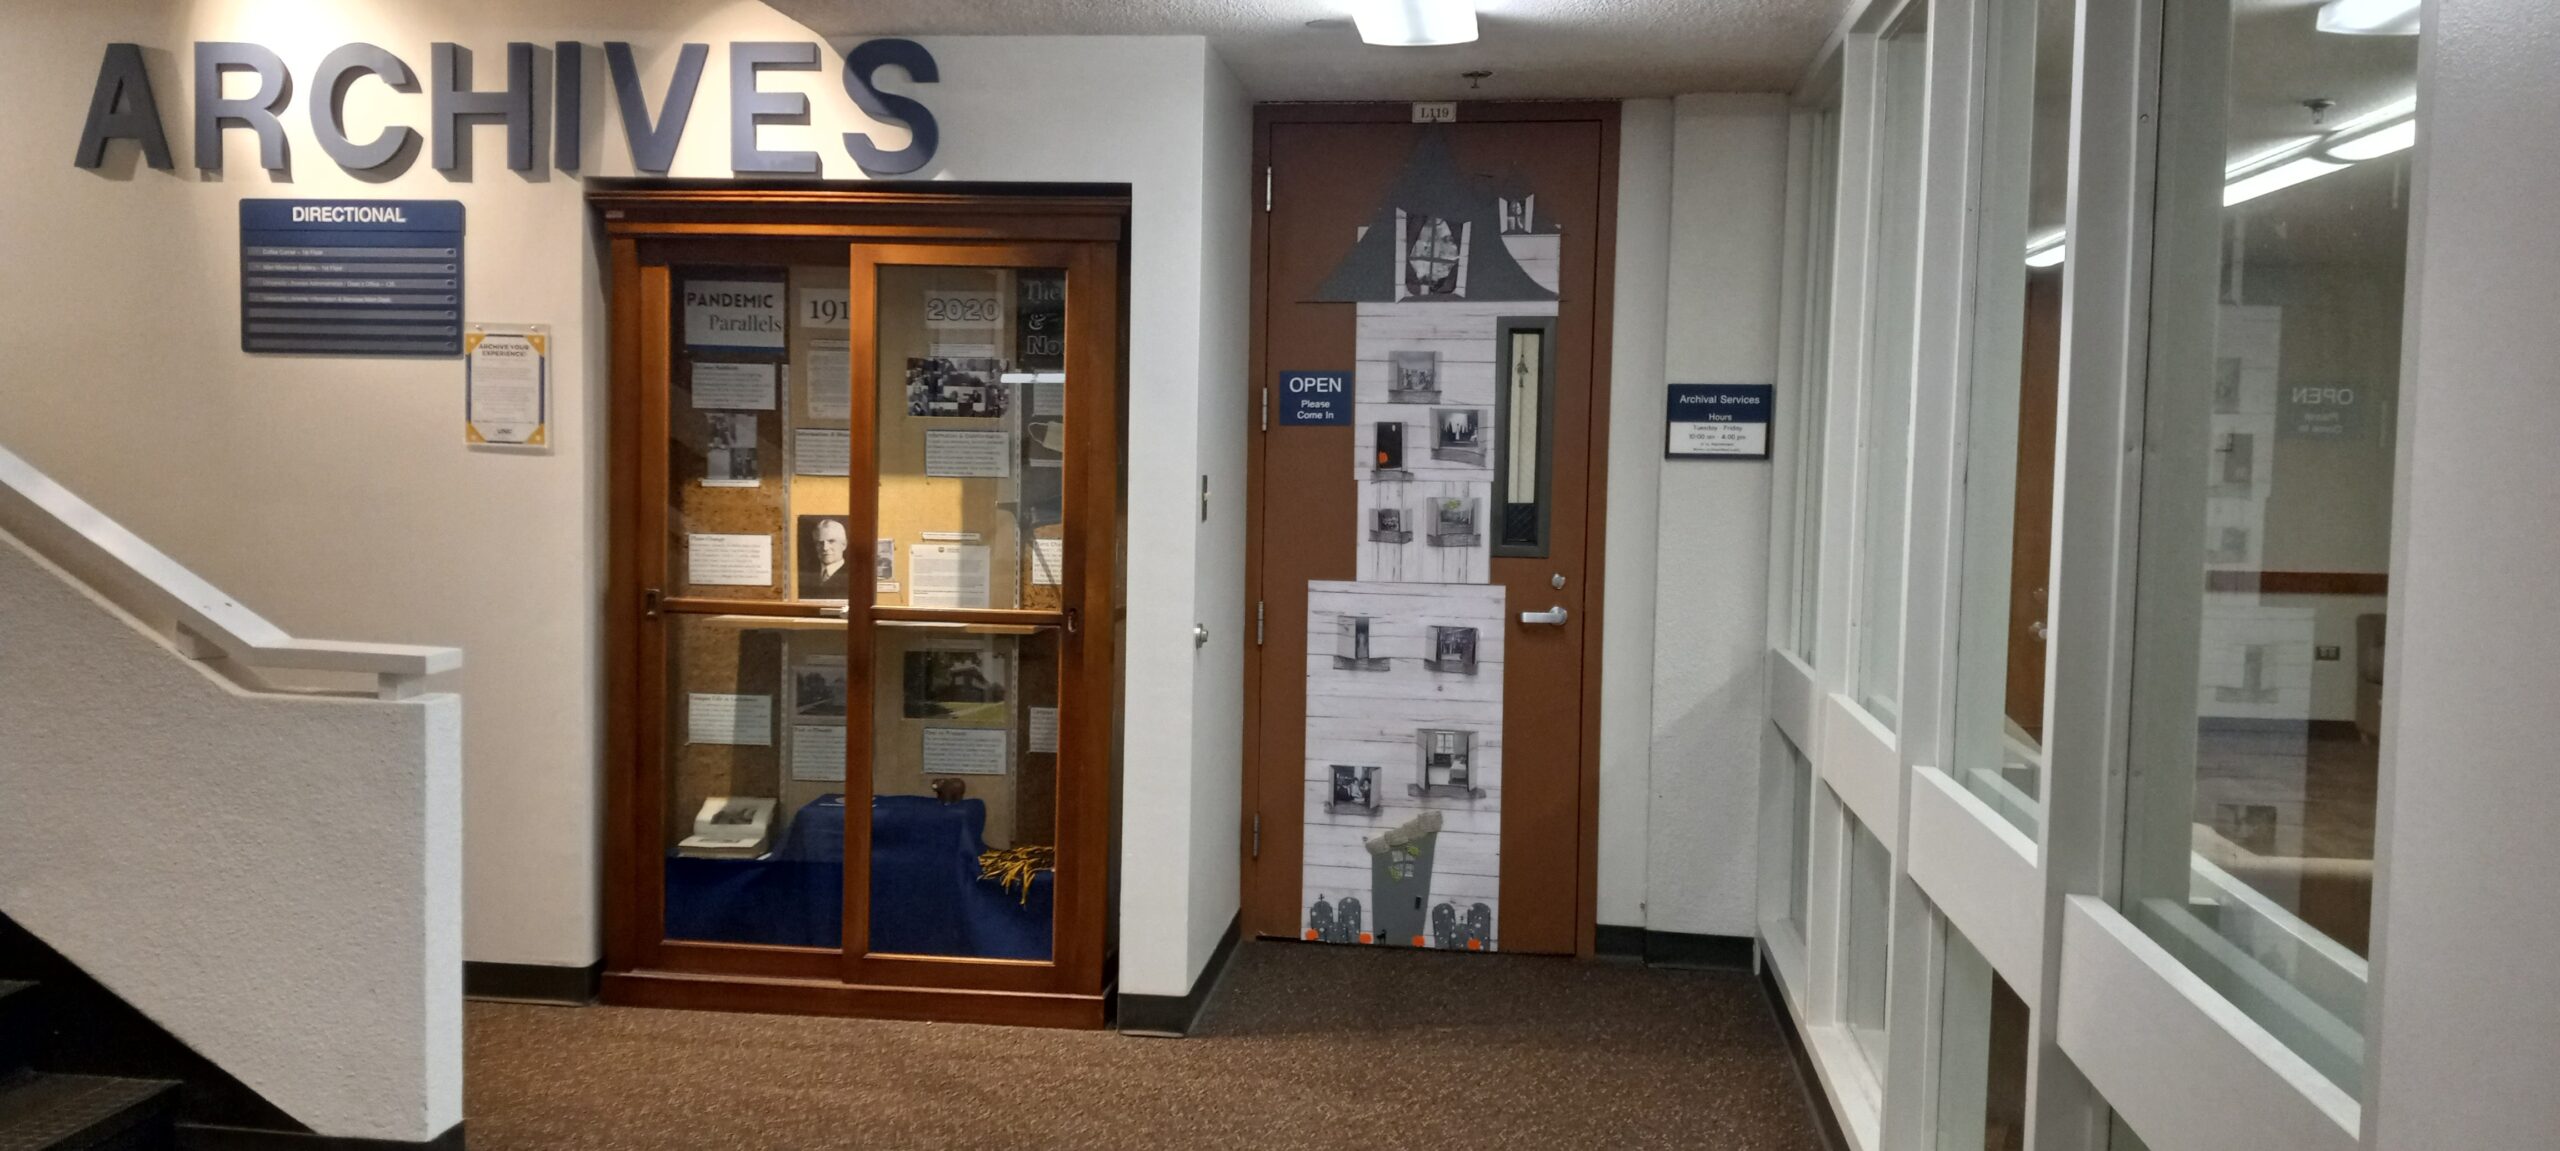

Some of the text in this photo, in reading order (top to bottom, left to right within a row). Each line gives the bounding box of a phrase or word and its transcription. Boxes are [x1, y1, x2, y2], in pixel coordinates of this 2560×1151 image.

[75, 38, 940, 178] ARCHIVES
[1421, 107, 1450, 119] L119
[292, 206, 406, 223] DIRECTIONAL
[1024, 280, 1064, 303] The
[687, 292, 774, 309] PANDEMIC
[926, 297, 1000, 321] 2020
[809, 298, 850, 324] 191
[709, 314, 783, 333] Parallels
[1028, 312, 1047, 330] &
[1026, 335, 1063, 356] No
[1289, 377, 1342, 393] OPEN
[1300, 399, 1331, 409] Please
[1679, 394, 1760, 404] Archival Services
[1296, 410, 1335, 420] Come In
[1708, 413, 1733, 421] Hours
